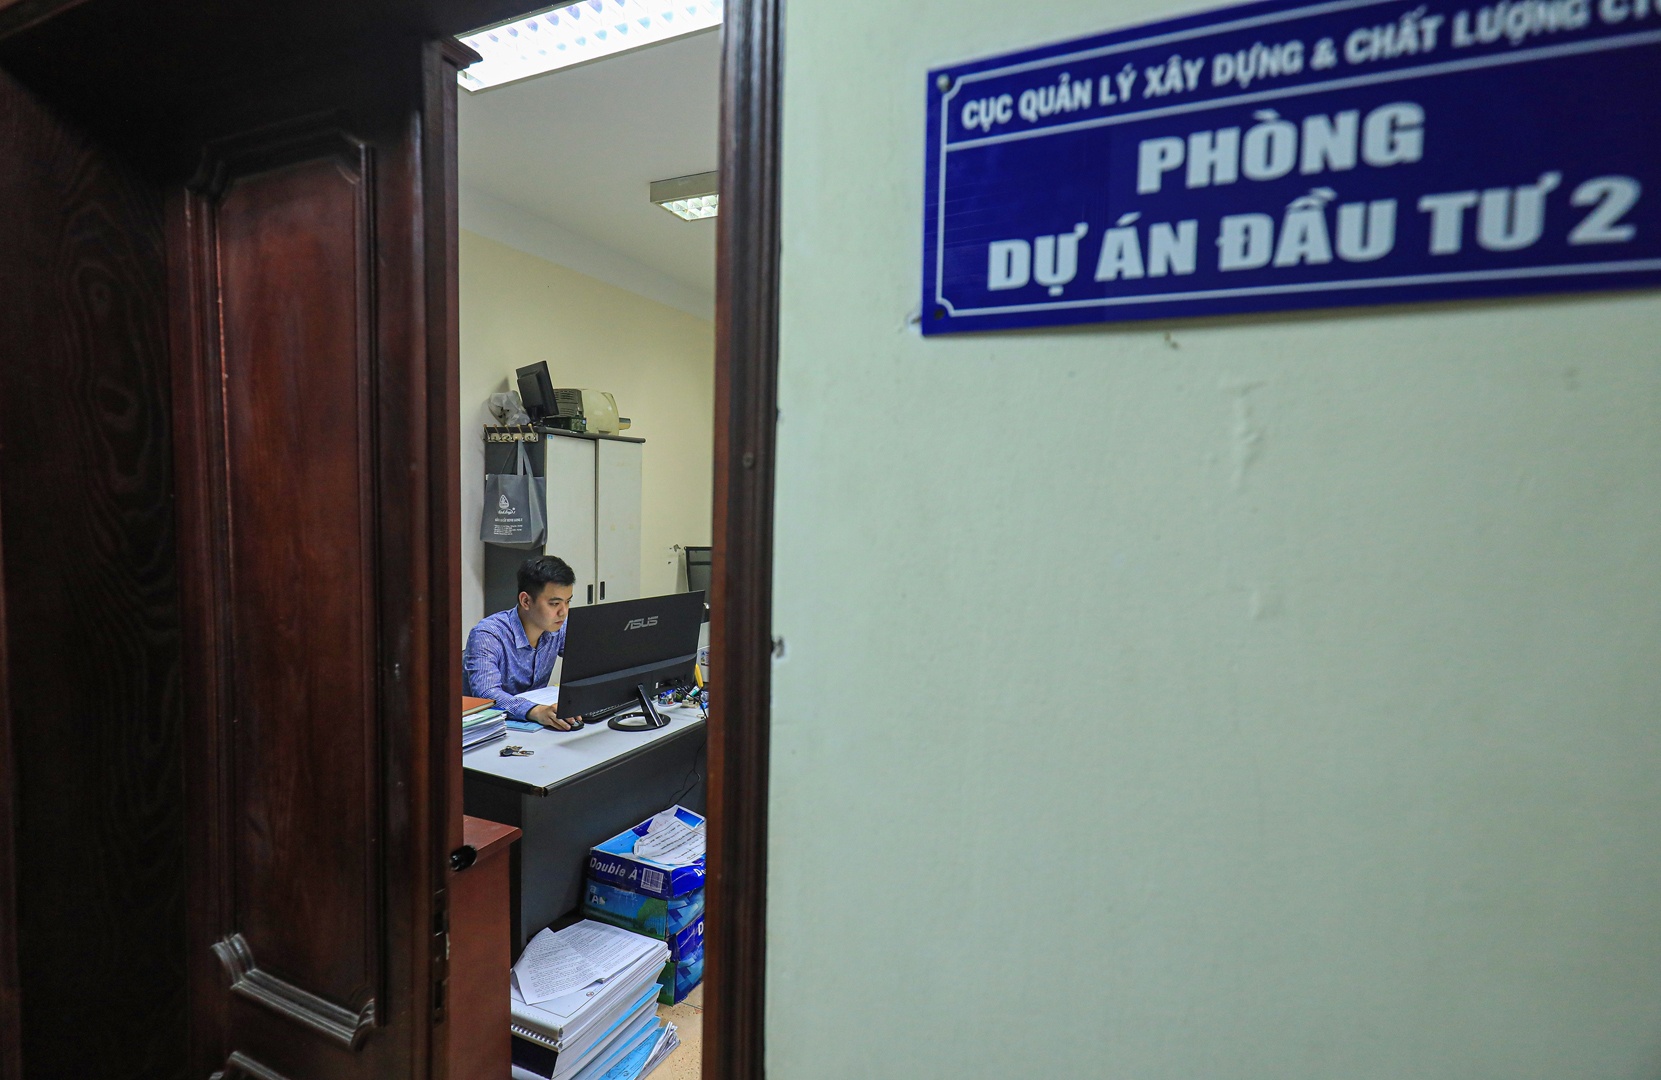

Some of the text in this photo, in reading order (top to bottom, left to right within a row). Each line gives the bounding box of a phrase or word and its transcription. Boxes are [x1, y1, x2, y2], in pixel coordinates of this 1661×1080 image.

[961, 93, 1013, 132] CỤC
[1018, 73, 1093, 122] QUẢN
[1099, 63, 1137, 106] LÝ
[1143, 54, 1204, 98] XÂY
[1211, 40, 1303, 88] DỰNG
[1309, 37, 1337, 69] &
[1345, 4, 1445, 64] CHẤT
[1137, 102, 1426, 194] PHÒNG
[987, 171, 1641, 296] DỰ ÁN ĐẦU TƯ 2
[624, 615, 659, 631] ASUS
[589, 857, 638, 881] Double A
